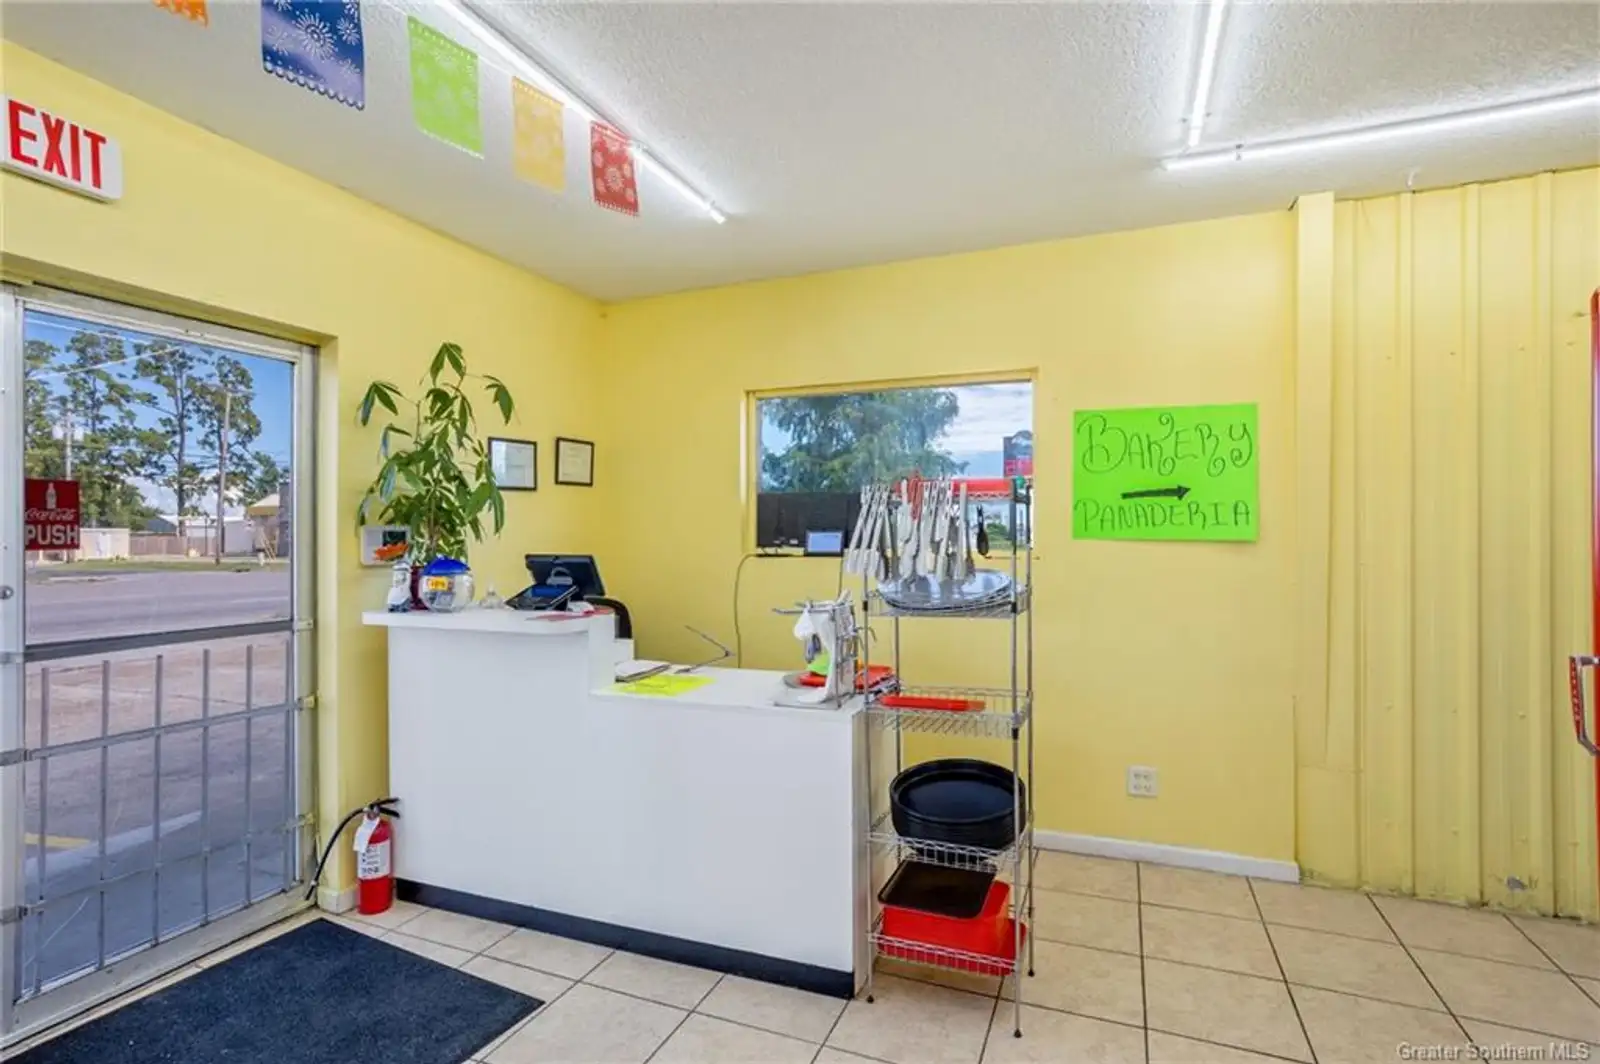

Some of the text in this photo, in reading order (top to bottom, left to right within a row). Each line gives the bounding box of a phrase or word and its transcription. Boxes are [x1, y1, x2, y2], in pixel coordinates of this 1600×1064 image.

[8, 99, 107, 190] EXIT
[1074, 498, 1250, 532] PANADERIA
[24, 524, 79, 546] PUSH
